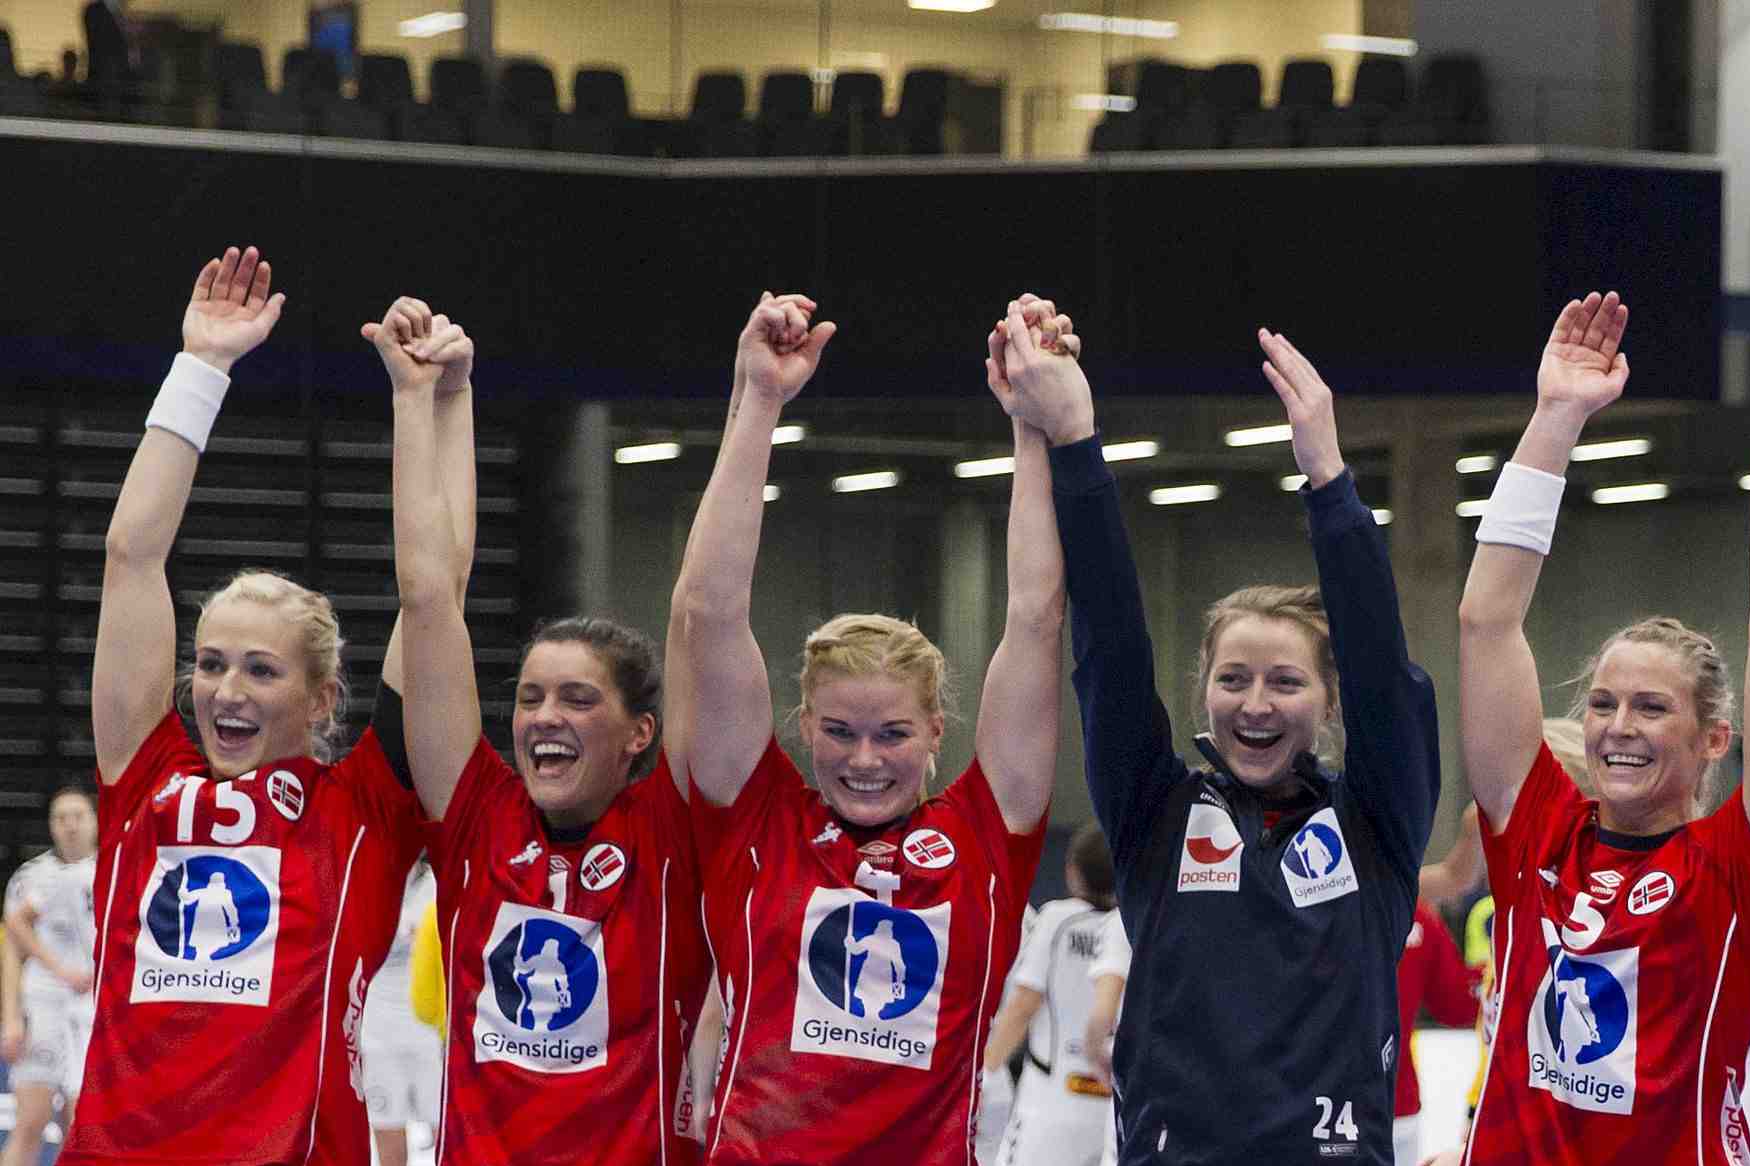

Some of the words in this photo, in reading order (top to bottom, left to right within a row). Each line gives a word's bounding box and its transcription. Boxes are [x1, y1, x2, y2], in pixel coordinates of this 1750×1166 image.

[1179, 868, 1239, 889] posten
[1295, 872, 1353, 899] Gjensidige
[141, 967, 261, 995] Gjensidige
[480, 1029, 599, 1066] Gjensidige
[803, 1018, 927, 1059] Gjensidige
[1312, 1096, 1360, 1141] 24
